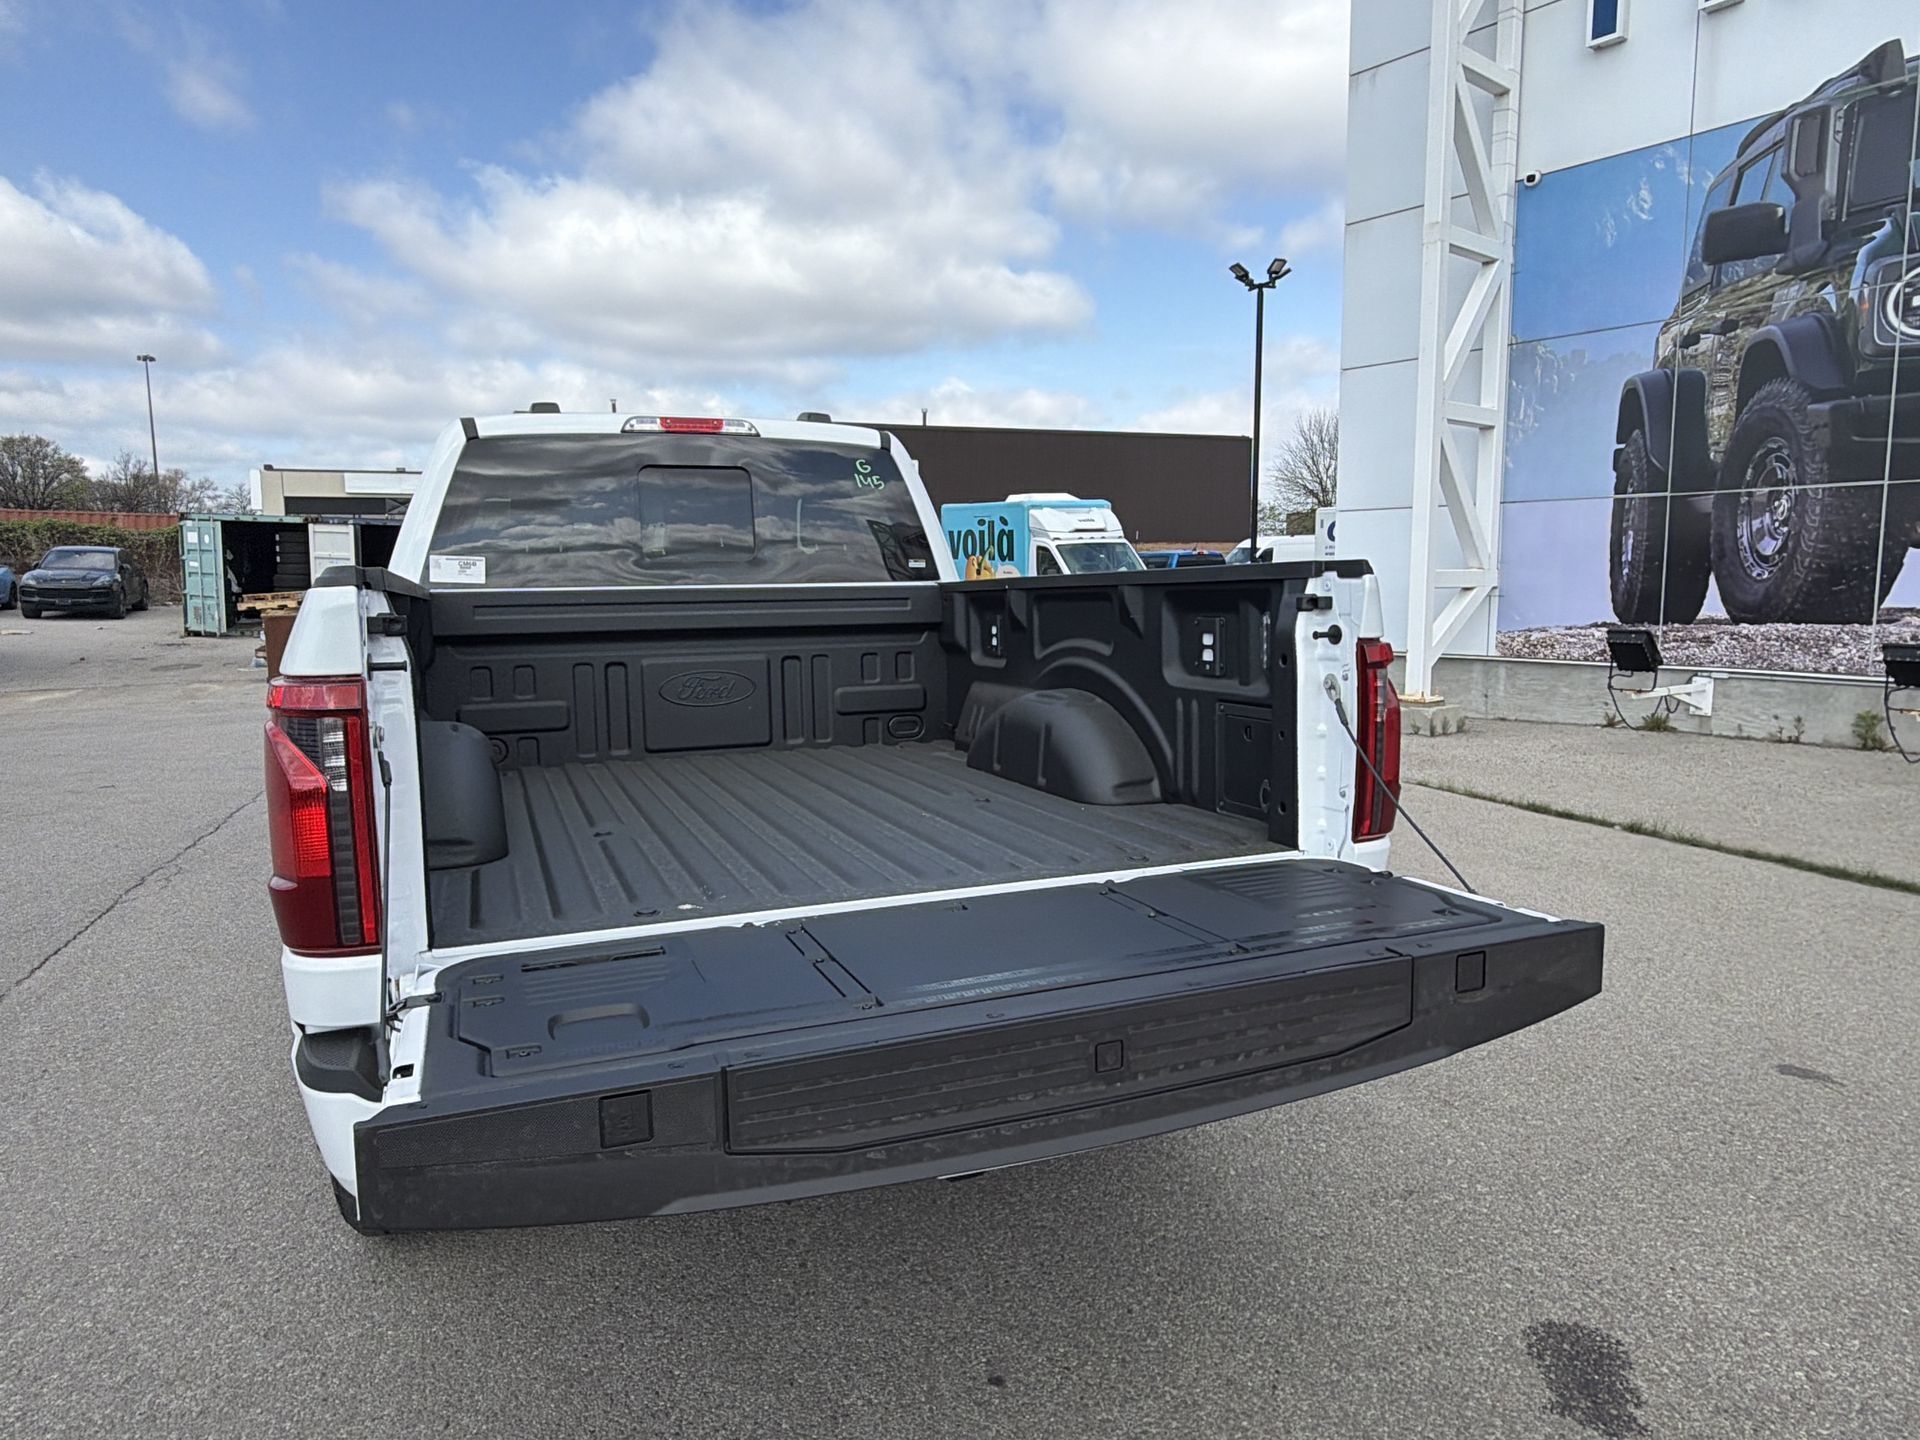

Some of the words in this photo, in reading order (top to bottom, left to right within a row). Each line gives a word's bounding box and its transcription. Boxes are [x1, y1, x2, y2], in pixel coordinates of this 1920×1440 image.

[854, 473, 885, 490] 145
[948, 516, 1015, 562] voilà
[678, 676, 736, 701] Ford
